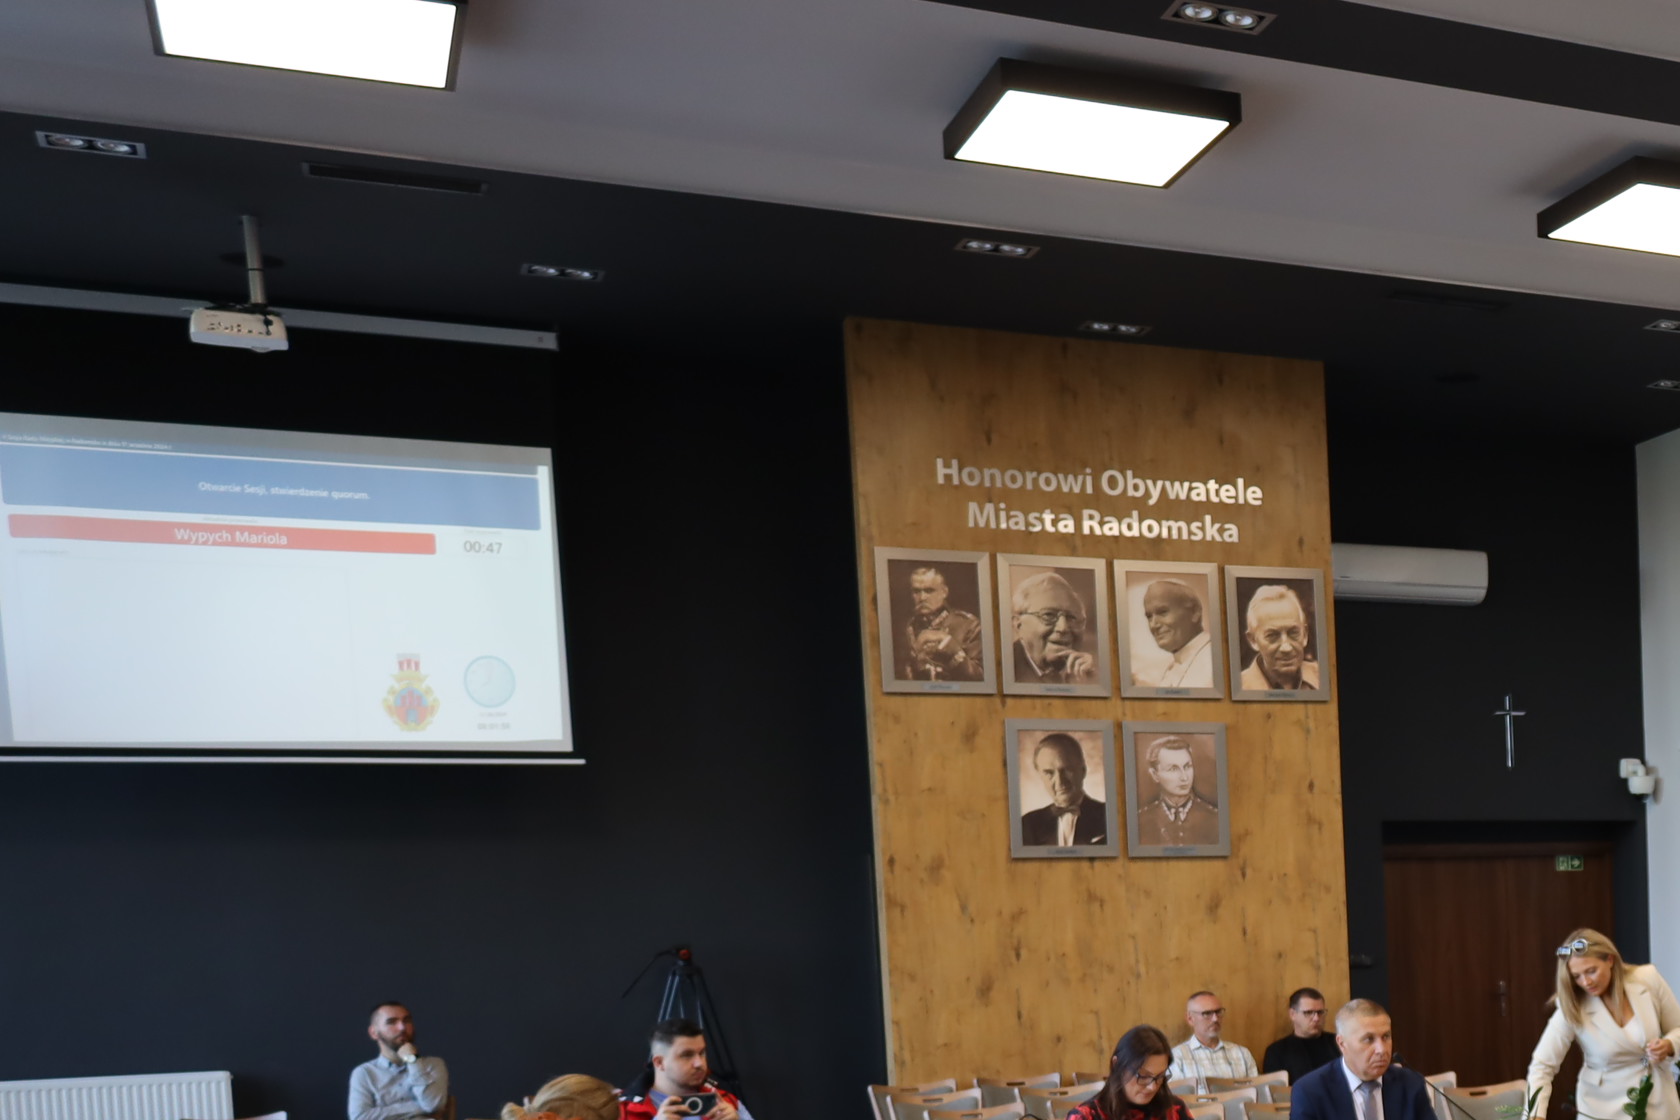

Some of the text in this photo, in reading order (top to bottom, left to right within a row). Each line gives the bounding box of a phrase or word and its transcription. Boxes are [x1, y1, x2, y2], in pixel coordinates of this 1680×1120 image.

[198, 481, 241, 493] Otwarcie
[270, 487, 329, 498] stwierdzenie
[331, 489, 370, 500] quorum.
[936, 458, 1263, 505] Honorowi Obywatele
[968, 502, 1239, 543] Miasta Radomska
[175, 527, 288, 545] Wypych Mariola
[463, 540, 503, 554] 00:47
